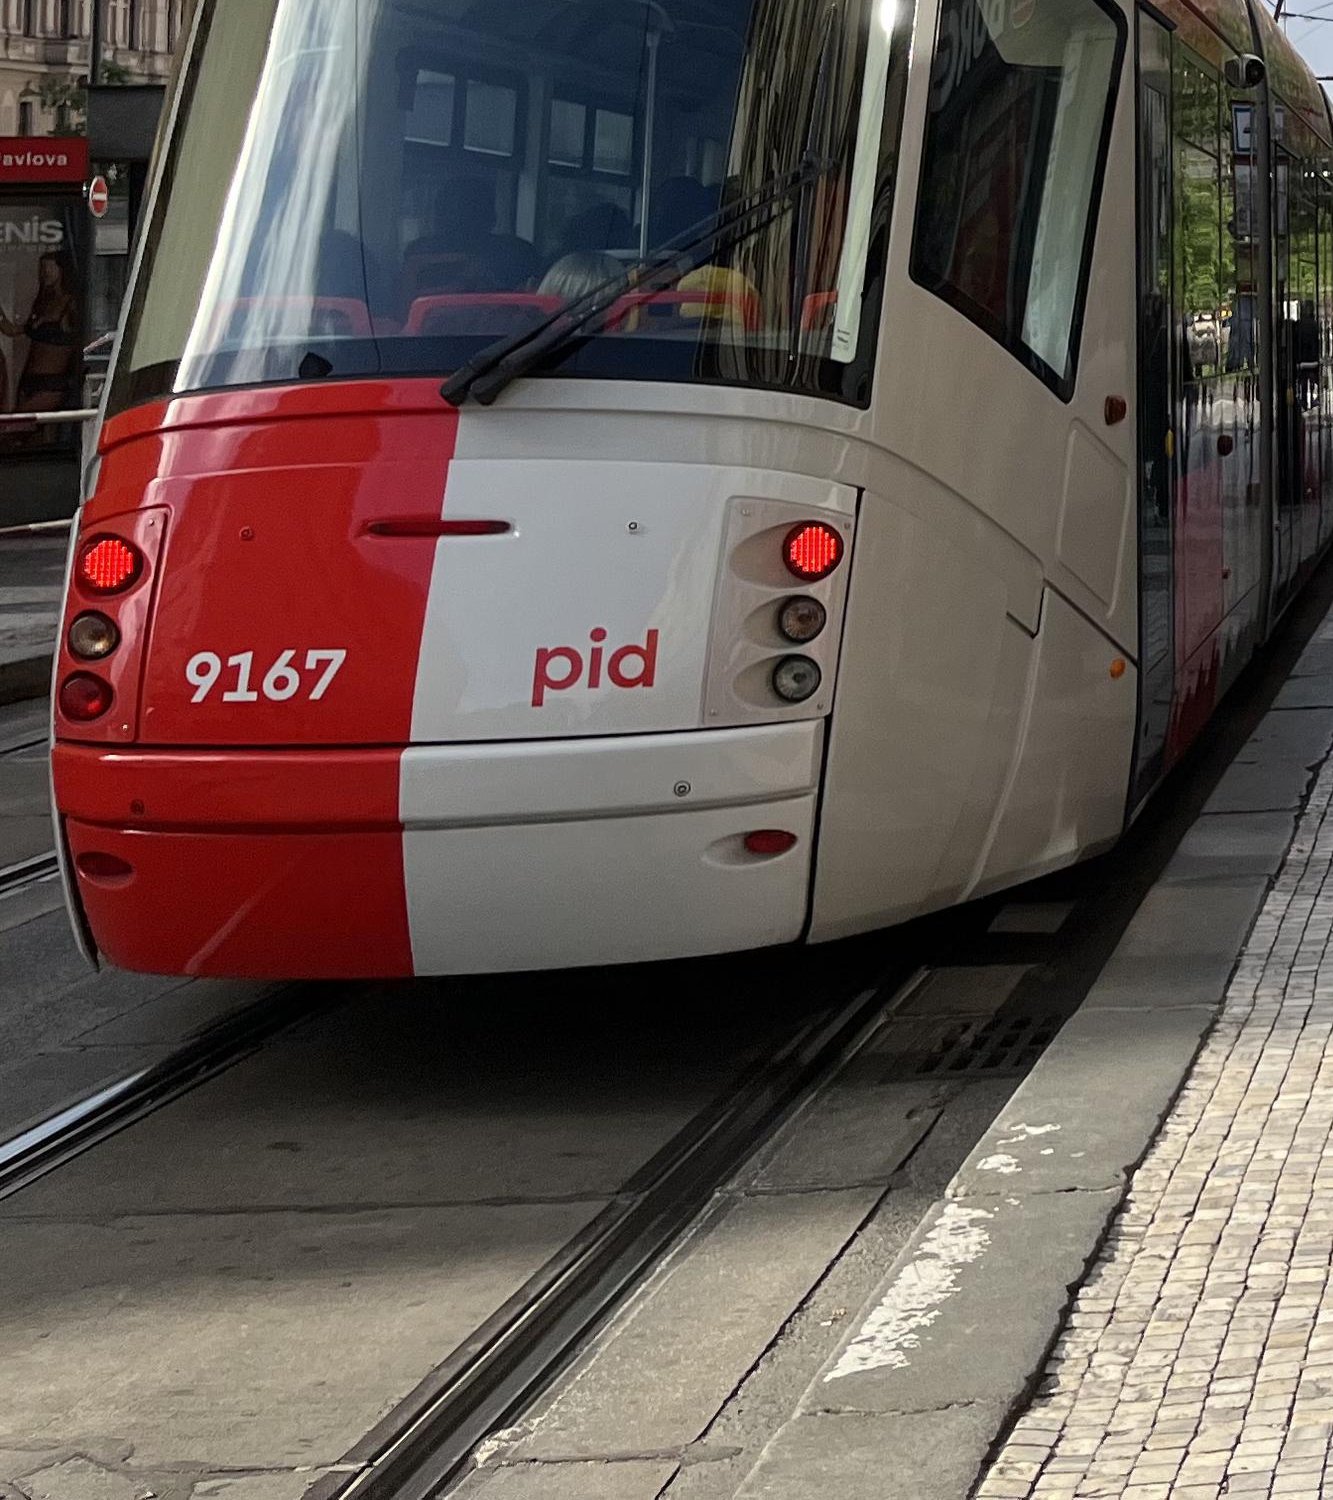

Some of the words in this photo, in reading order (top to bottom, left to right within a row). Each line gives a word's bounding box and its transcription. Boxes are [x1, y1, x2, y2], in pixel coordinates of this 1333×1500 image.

[0, 151, 68, 167] avlova
[185, 649, 347, 704] 9167
[532, 627, 658, 707] pid
